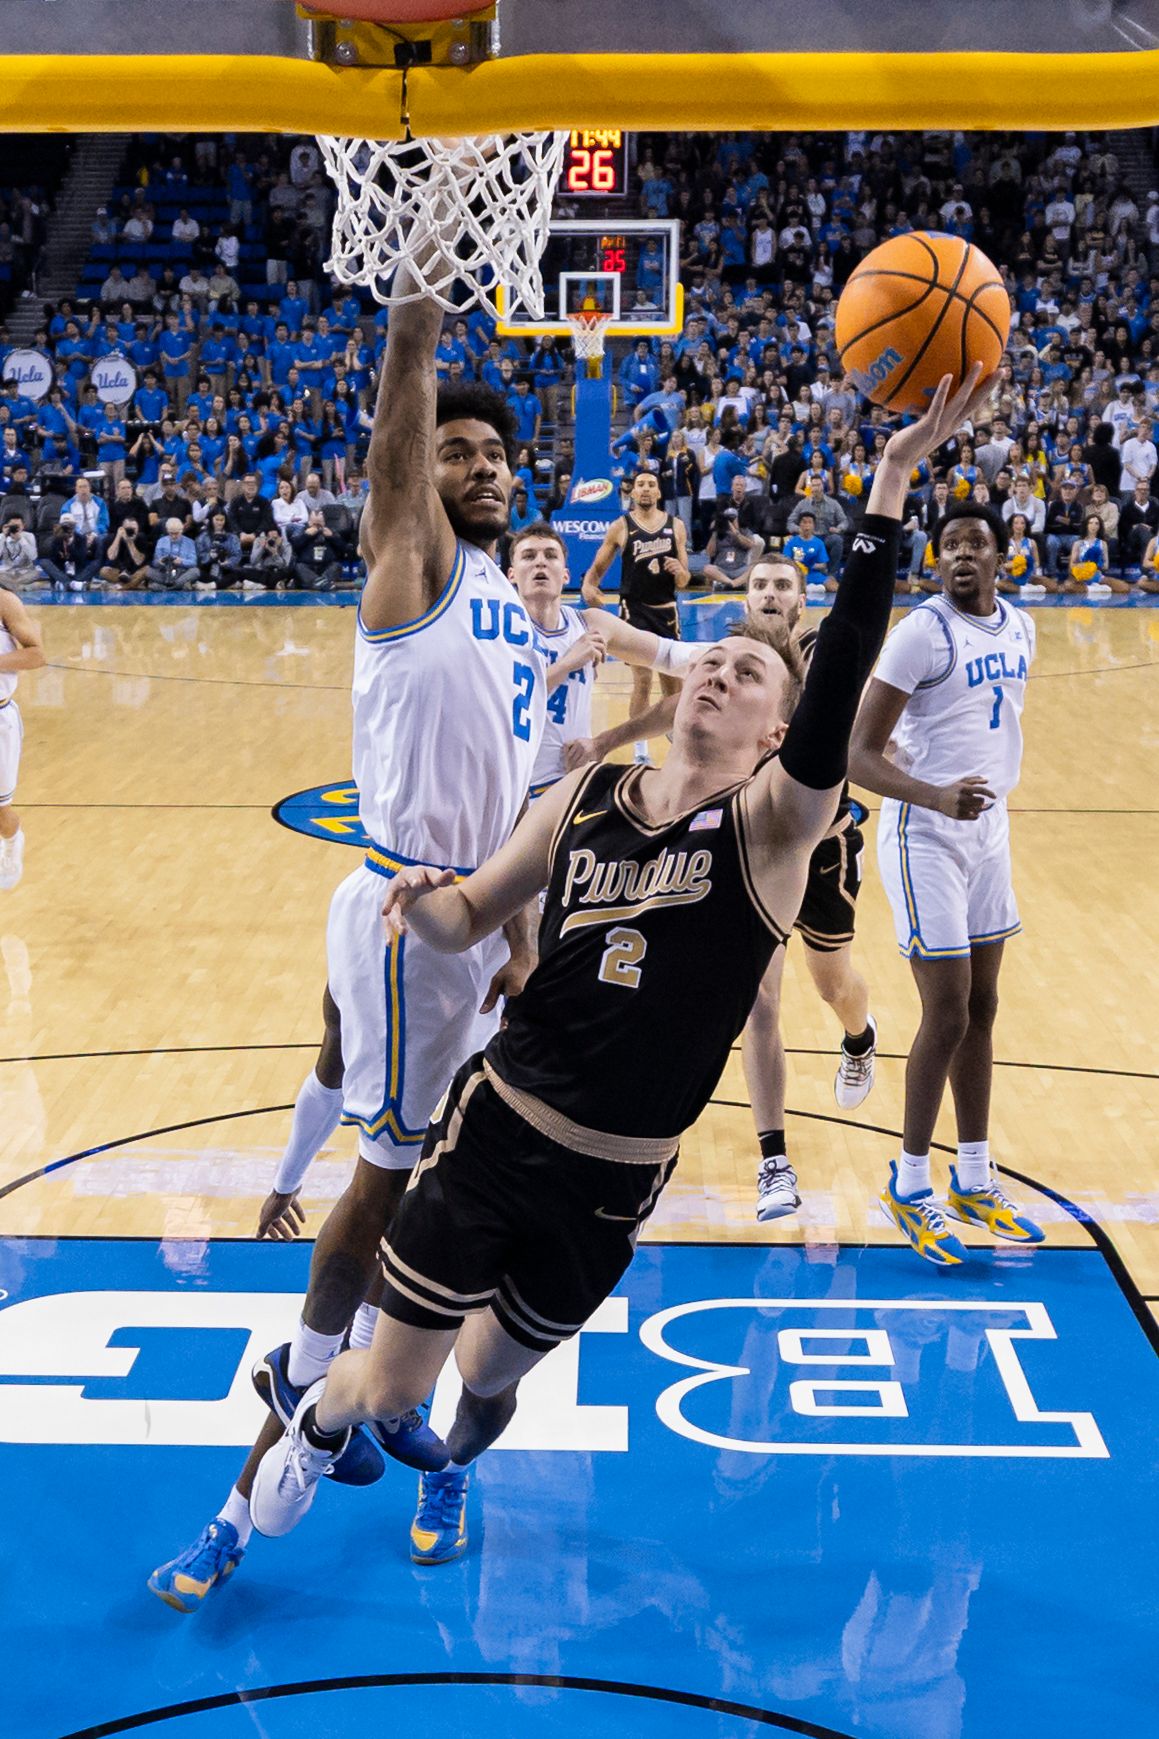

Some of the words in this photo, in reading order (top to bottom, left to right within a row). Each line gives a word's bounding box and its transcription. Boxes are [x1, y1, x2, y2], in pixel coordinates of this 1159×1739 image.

[568, 150, 615, 190] 26
[97, 371, 129, 389] Ucla
[648, 558, 660, 575] 4
[965, 652, 1027, 688] UCLA
[513, 660, 535, 742] 2
[547, 684, 569, 725] 4
[989, 685, 1004, 729] 1
[562, 847, 712, 908] Purdue
[598, 926, 647, 988] 2
